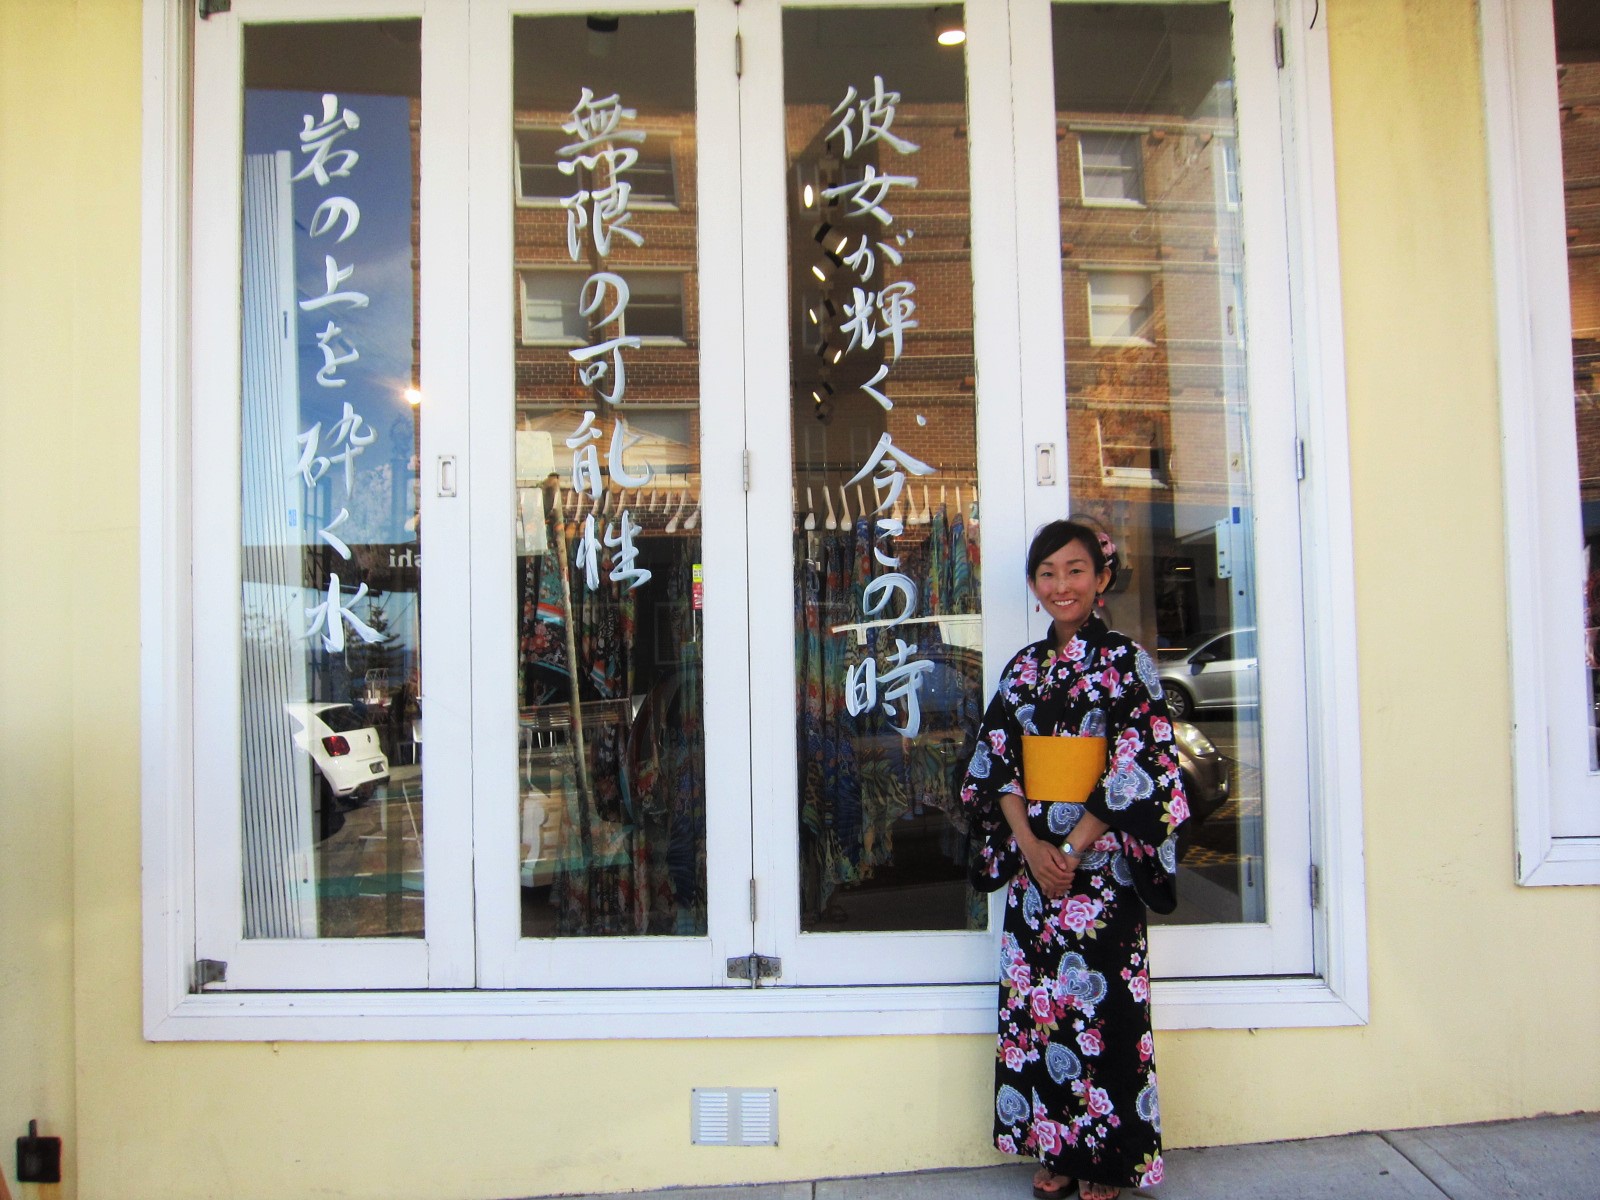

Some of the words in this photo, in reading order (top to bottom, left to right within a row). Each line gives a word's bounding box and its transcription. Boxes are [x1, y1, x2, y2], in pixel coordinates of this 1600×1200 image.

[554, 87, 652, 590] 無限の可能性
